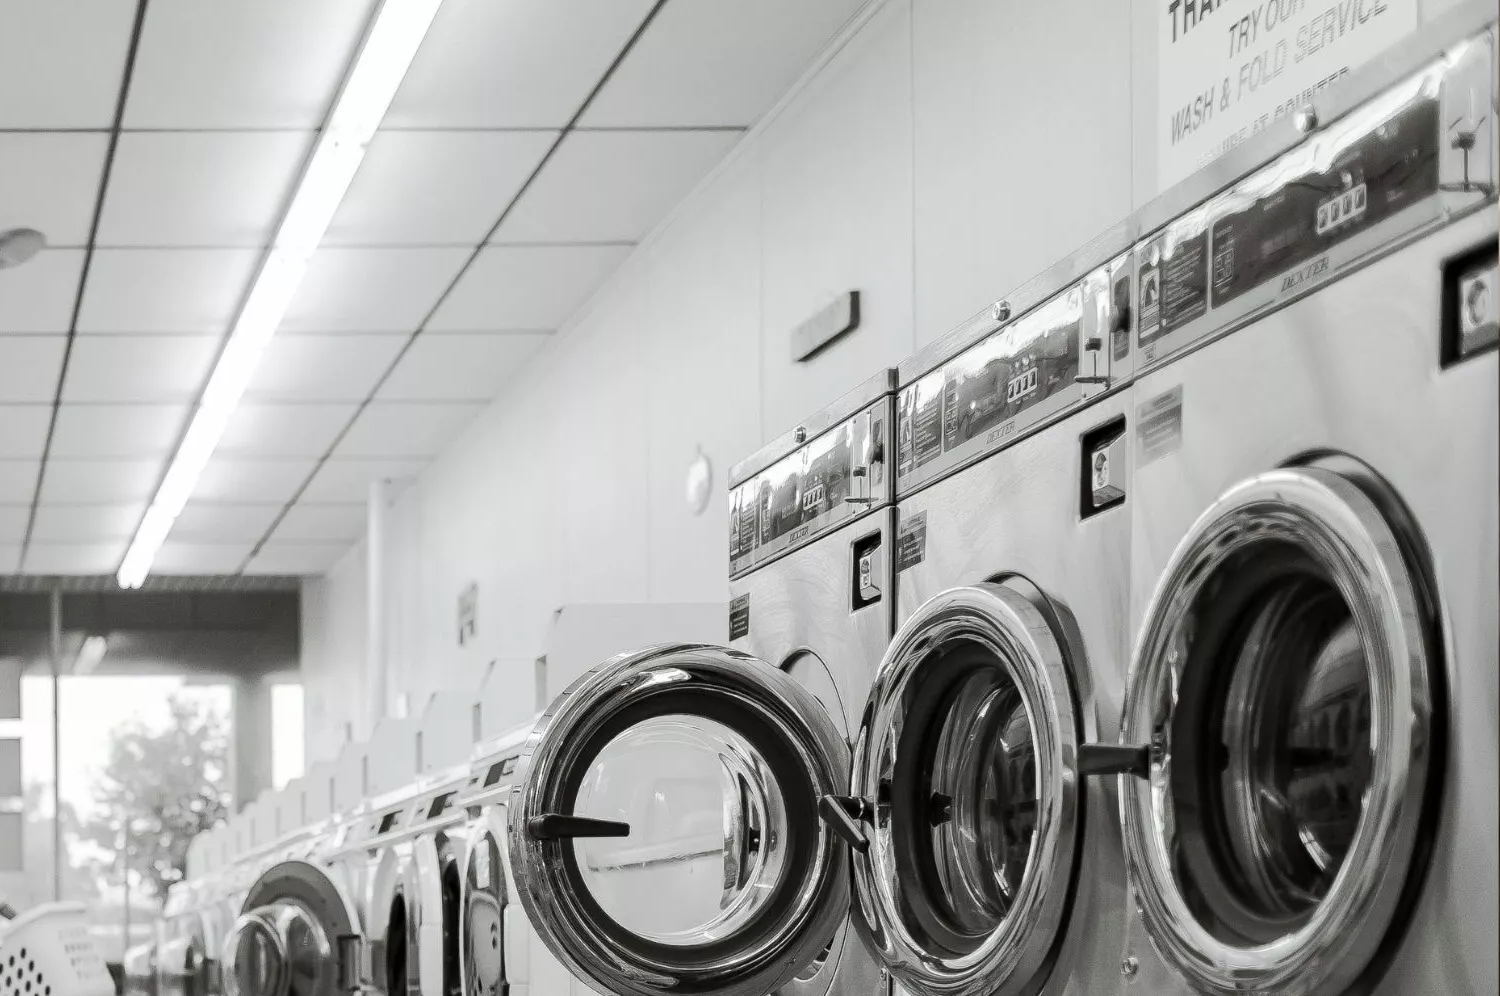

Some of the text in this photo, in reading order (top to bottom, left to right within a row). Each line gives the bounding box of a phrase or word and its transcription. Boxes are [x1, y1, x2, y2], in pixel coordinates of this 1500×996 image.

[1168, 0, 1228, 43] THA
[1228, 5, 1264, 59] TRY
[1171, 85, 1215, 147] WASH
[1219, 76, 1232, 112] &
[1237, 38, 1288, 101] FOLD
[1280, 257, 1331, 294] DEXTER
